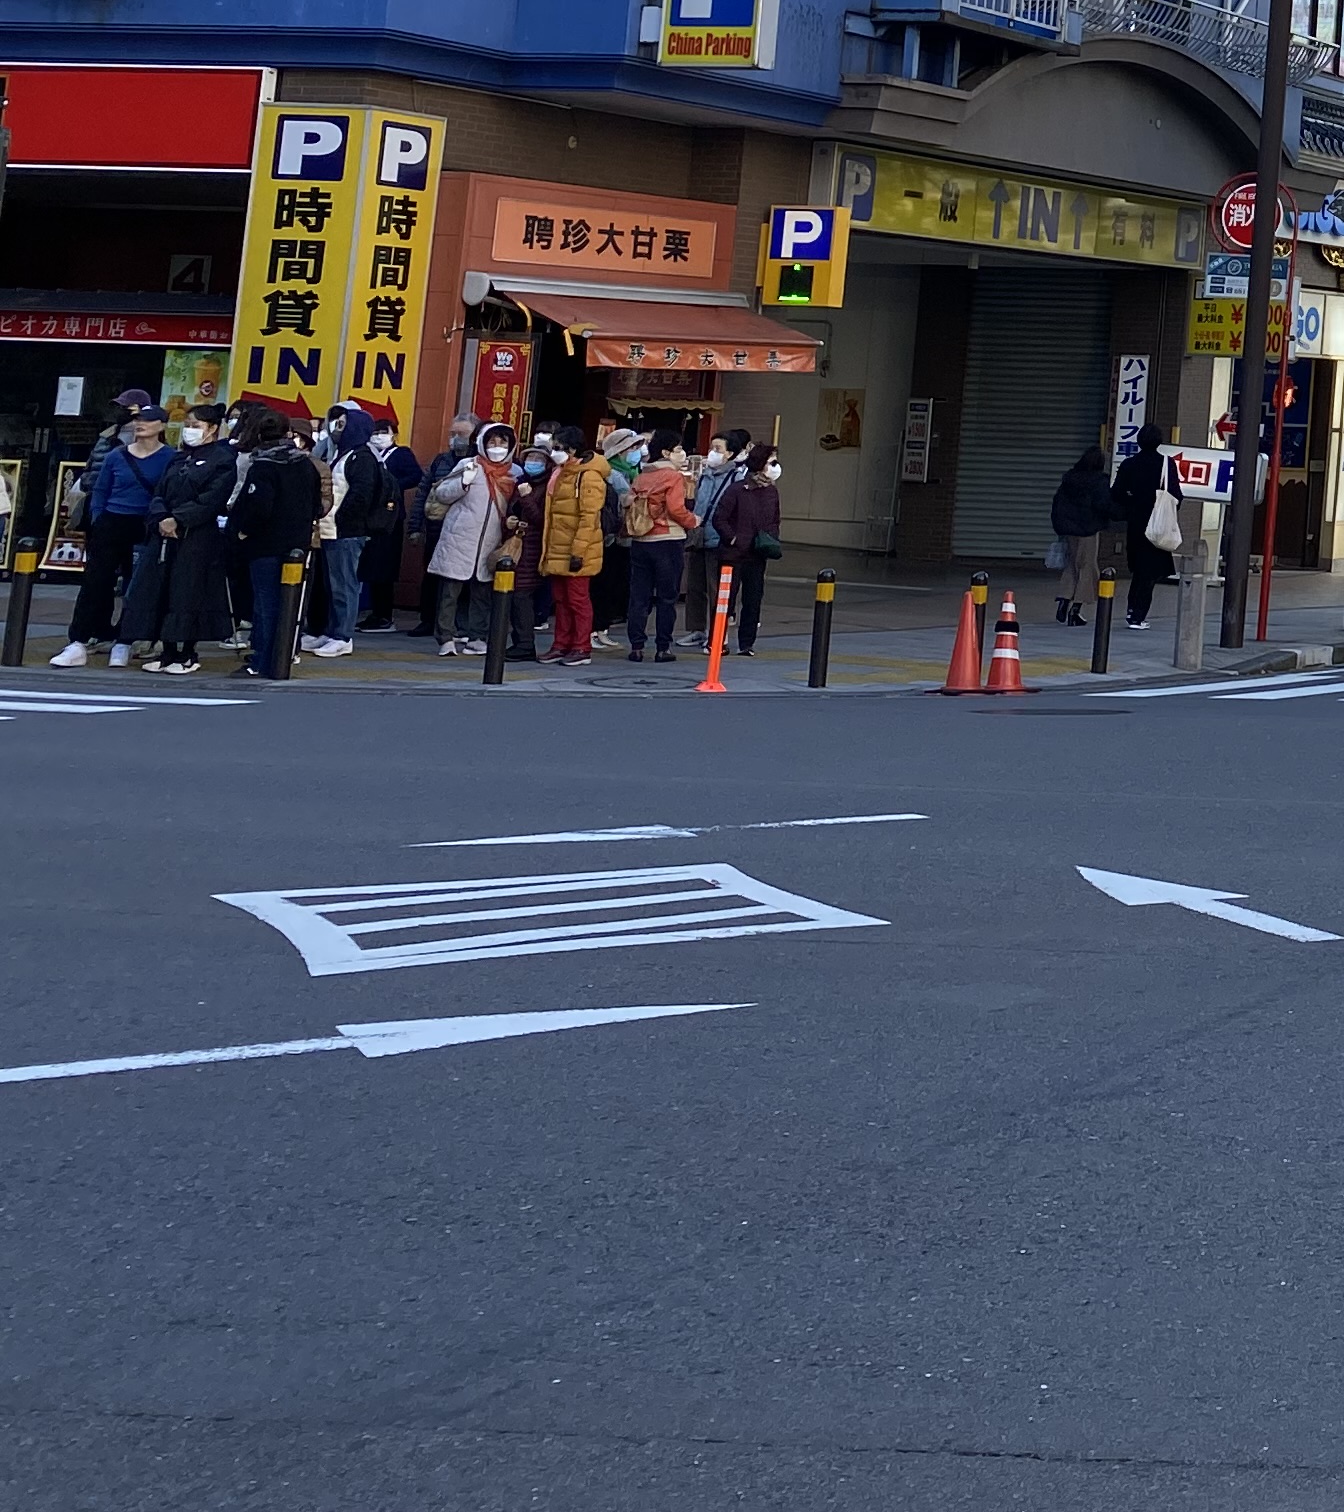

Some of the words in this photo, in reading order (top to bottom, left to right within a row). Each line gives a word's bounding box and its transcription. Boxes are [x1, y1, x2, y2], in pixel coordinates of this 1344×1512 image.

[667, 32, 703, 56] China
[704, 33, 753, 59] Parking
[276, 119, 344, 176] P
[379, 127, 428, 184] P
[522, 214, 692, 263] 聘珍大甘栗
[780, 210, 823, 259] P
[903, 178, 961, 224] 一般
[1017, 184, 1062, 244] IN
[1109, 208, 1156, 250] 有料
[259, 187, 333, 338] 時間貸
[362, 194, 418, 343] 時間貸
[1196, 313, 1224, 324] 最大料金
[247, 345, 322, 387] IN
[627, 342, 782, 370] 聘珍大甘栗
[1194, 341, 1222, 351] 最大料金
[352, 351, 406, 391] IN
[1115, 358, 1147, 458] ハイルーフ車
